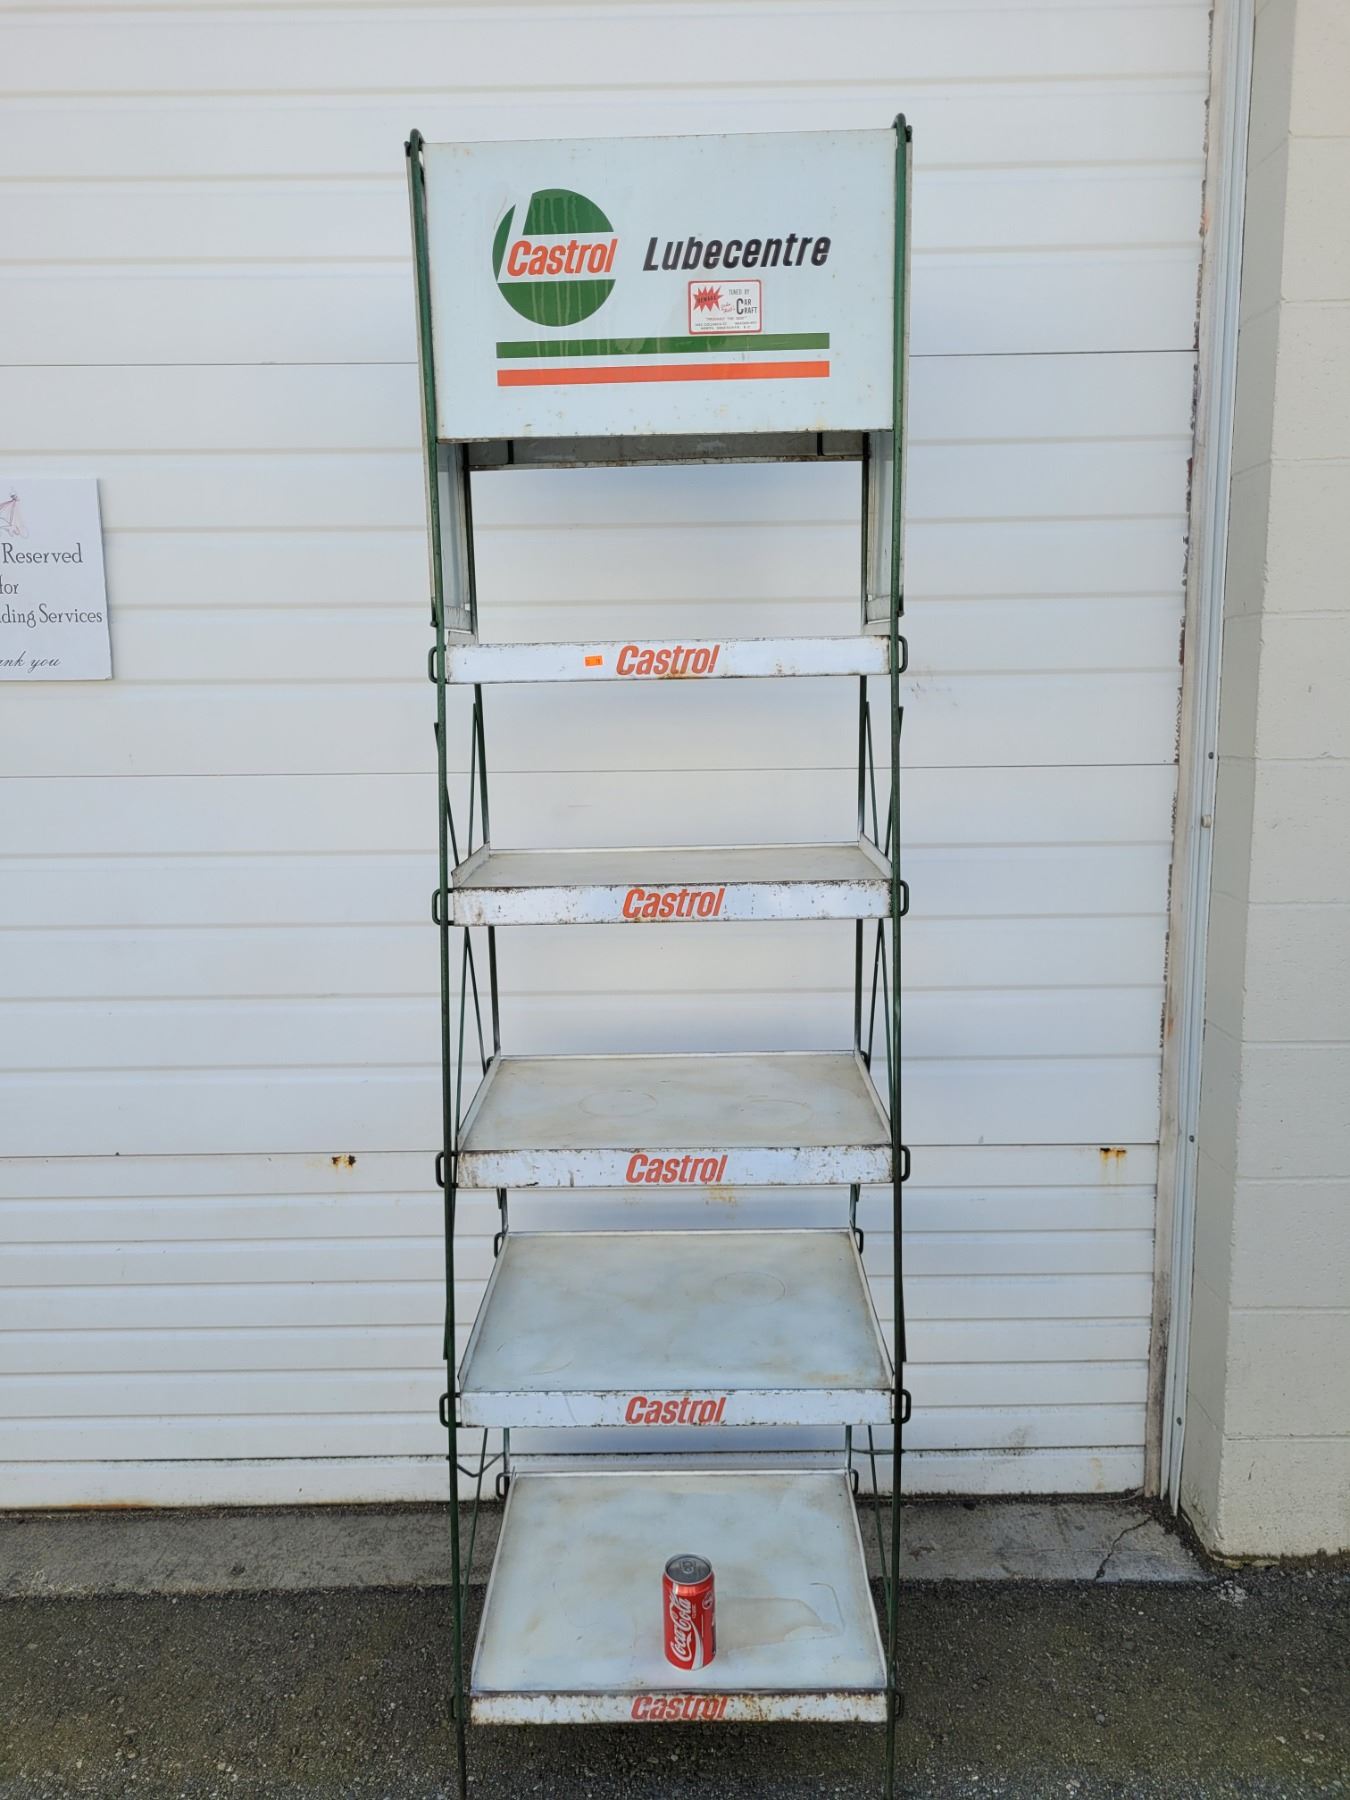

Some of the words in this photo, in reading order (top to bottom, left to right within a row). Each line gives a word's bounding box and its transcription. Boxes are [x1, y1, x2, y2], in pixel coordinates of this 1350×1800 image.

[507, 238, 618, 277] Castrol
[642, 232, 832, 272] Lubecentre
[729, 288, 742, 296] TUNED
[2, 542, 83, 564] Reserved
[0, 603, 37, 628] ding
[38, 602, 103, 624] Services
[28, 658, 61, 673] you
[616, 644, 720, 677] Castrol
[622, 887, 725, 919] Castrol
[625, 1153, 728, 1183] Castrol
[625, 1395, 727, 1425] Castrol
[632, 1695, 728, 1721] Castrol
